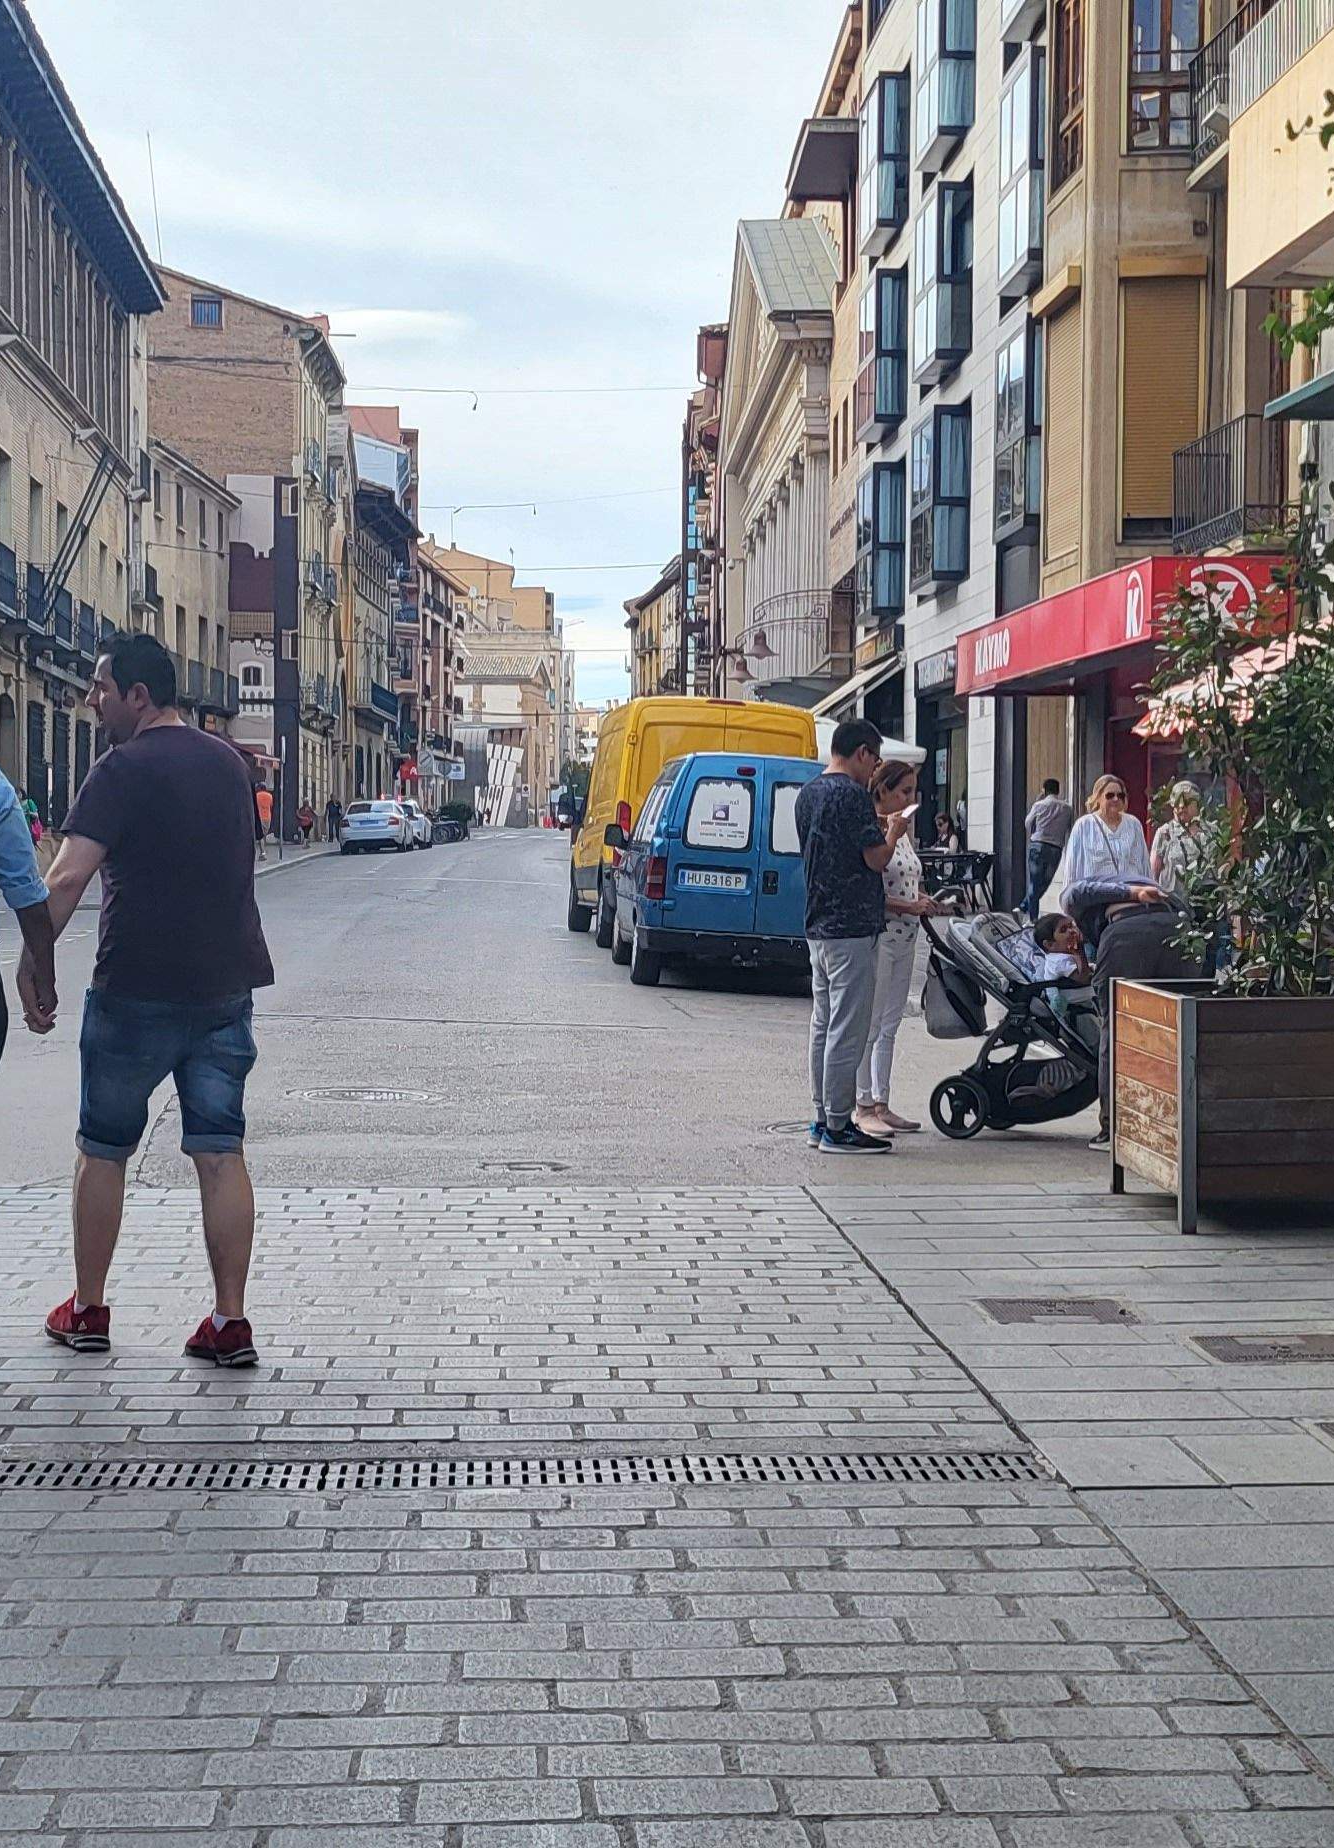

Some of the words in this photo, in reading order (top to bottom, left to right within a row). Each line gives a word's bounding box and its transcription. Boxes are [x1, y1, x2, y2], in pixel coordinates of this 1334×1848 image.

[975, 628, 1010, 676] KAYMO
[687, 873, 702, 883] HU
[703, 873, 732, 886] 8316
[735, 876, 742, 886] P
